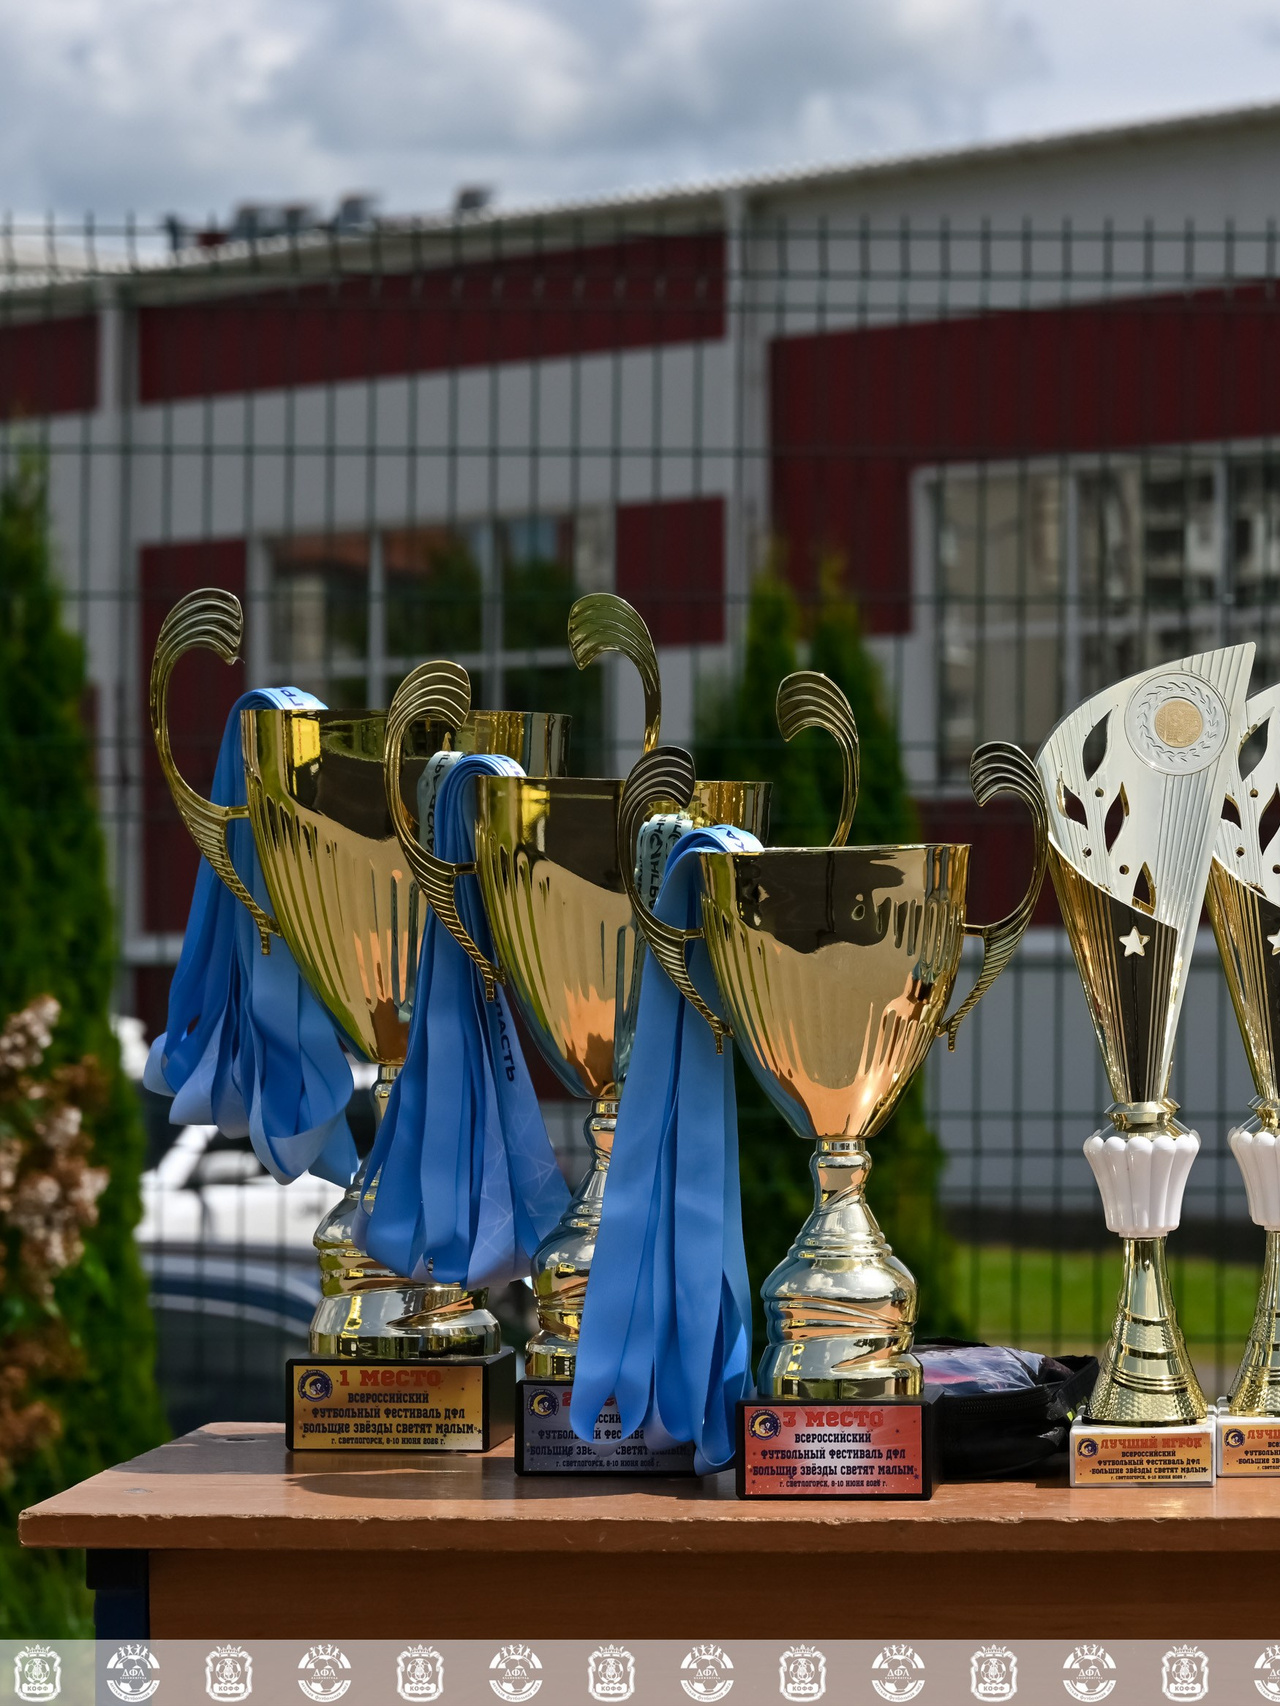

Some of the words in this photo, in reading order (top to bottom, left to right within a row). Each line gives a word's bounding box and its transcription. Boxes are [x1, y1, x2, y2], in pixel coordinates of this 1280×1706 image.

[340, 1370, 350, 1387] 1
[348, 1391, 429, 1403] ВСЕРОССИЙСКИЙ
[312, 1406, 381, 1419] ФУТБОЛЬНЫЙ
[383, 1408, 441, 1419] ФЕСТИВАЛЬ
[444, 1408, 465, 1420] ДФЛ
[782, 1411, 796, 1428] 3
[353, 1420, 393, 1434] ЗВЁЗДЫ
[396, 1423, 432, 1433] СВЕТЯТ
[795, 1431, 871, 1444] ВСЕРОССИЙСКИЙ
[1162, 1437, 1202, 1449] ИГРОК
[760, 1447, 826, 1460] ФУТБОЛЬНЫЙ
[828, 1449, 883, 1459] ФЕСТИВАЛЬ
[886, 1449, 906, 1461] ДФЛ
[800, 1463, 838, 1477] ЗВЁЗДЫ
[840, 1465, 875, 1476] СВЕТЯТ
